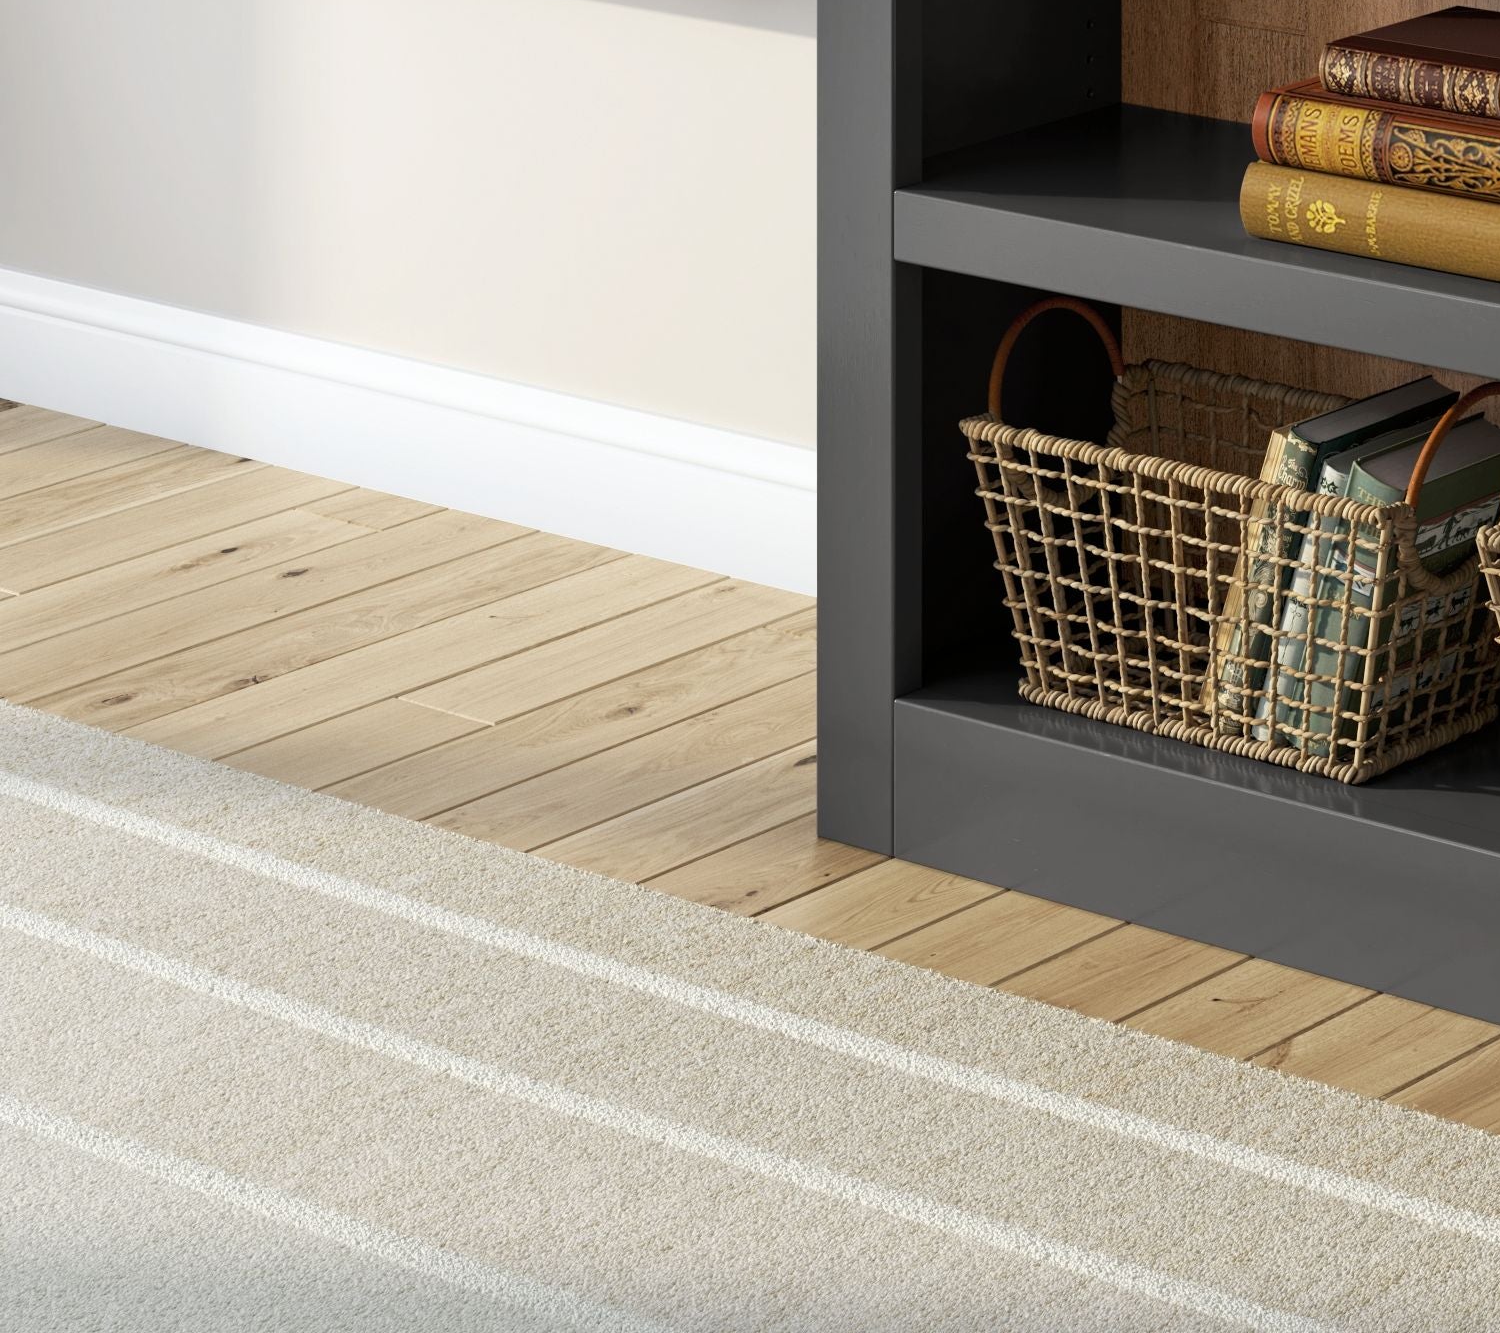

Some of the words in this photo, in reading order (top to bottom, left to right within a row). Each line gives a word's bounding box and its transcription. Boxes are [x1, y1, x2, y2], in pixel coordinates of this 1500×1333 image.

[1266, 183, 1282, 233] TOMMY
[1287, 221, 1302, 242] AND
[1278, 463, 1306, 490] Charm
[1288, 459, 1298, 472] The
